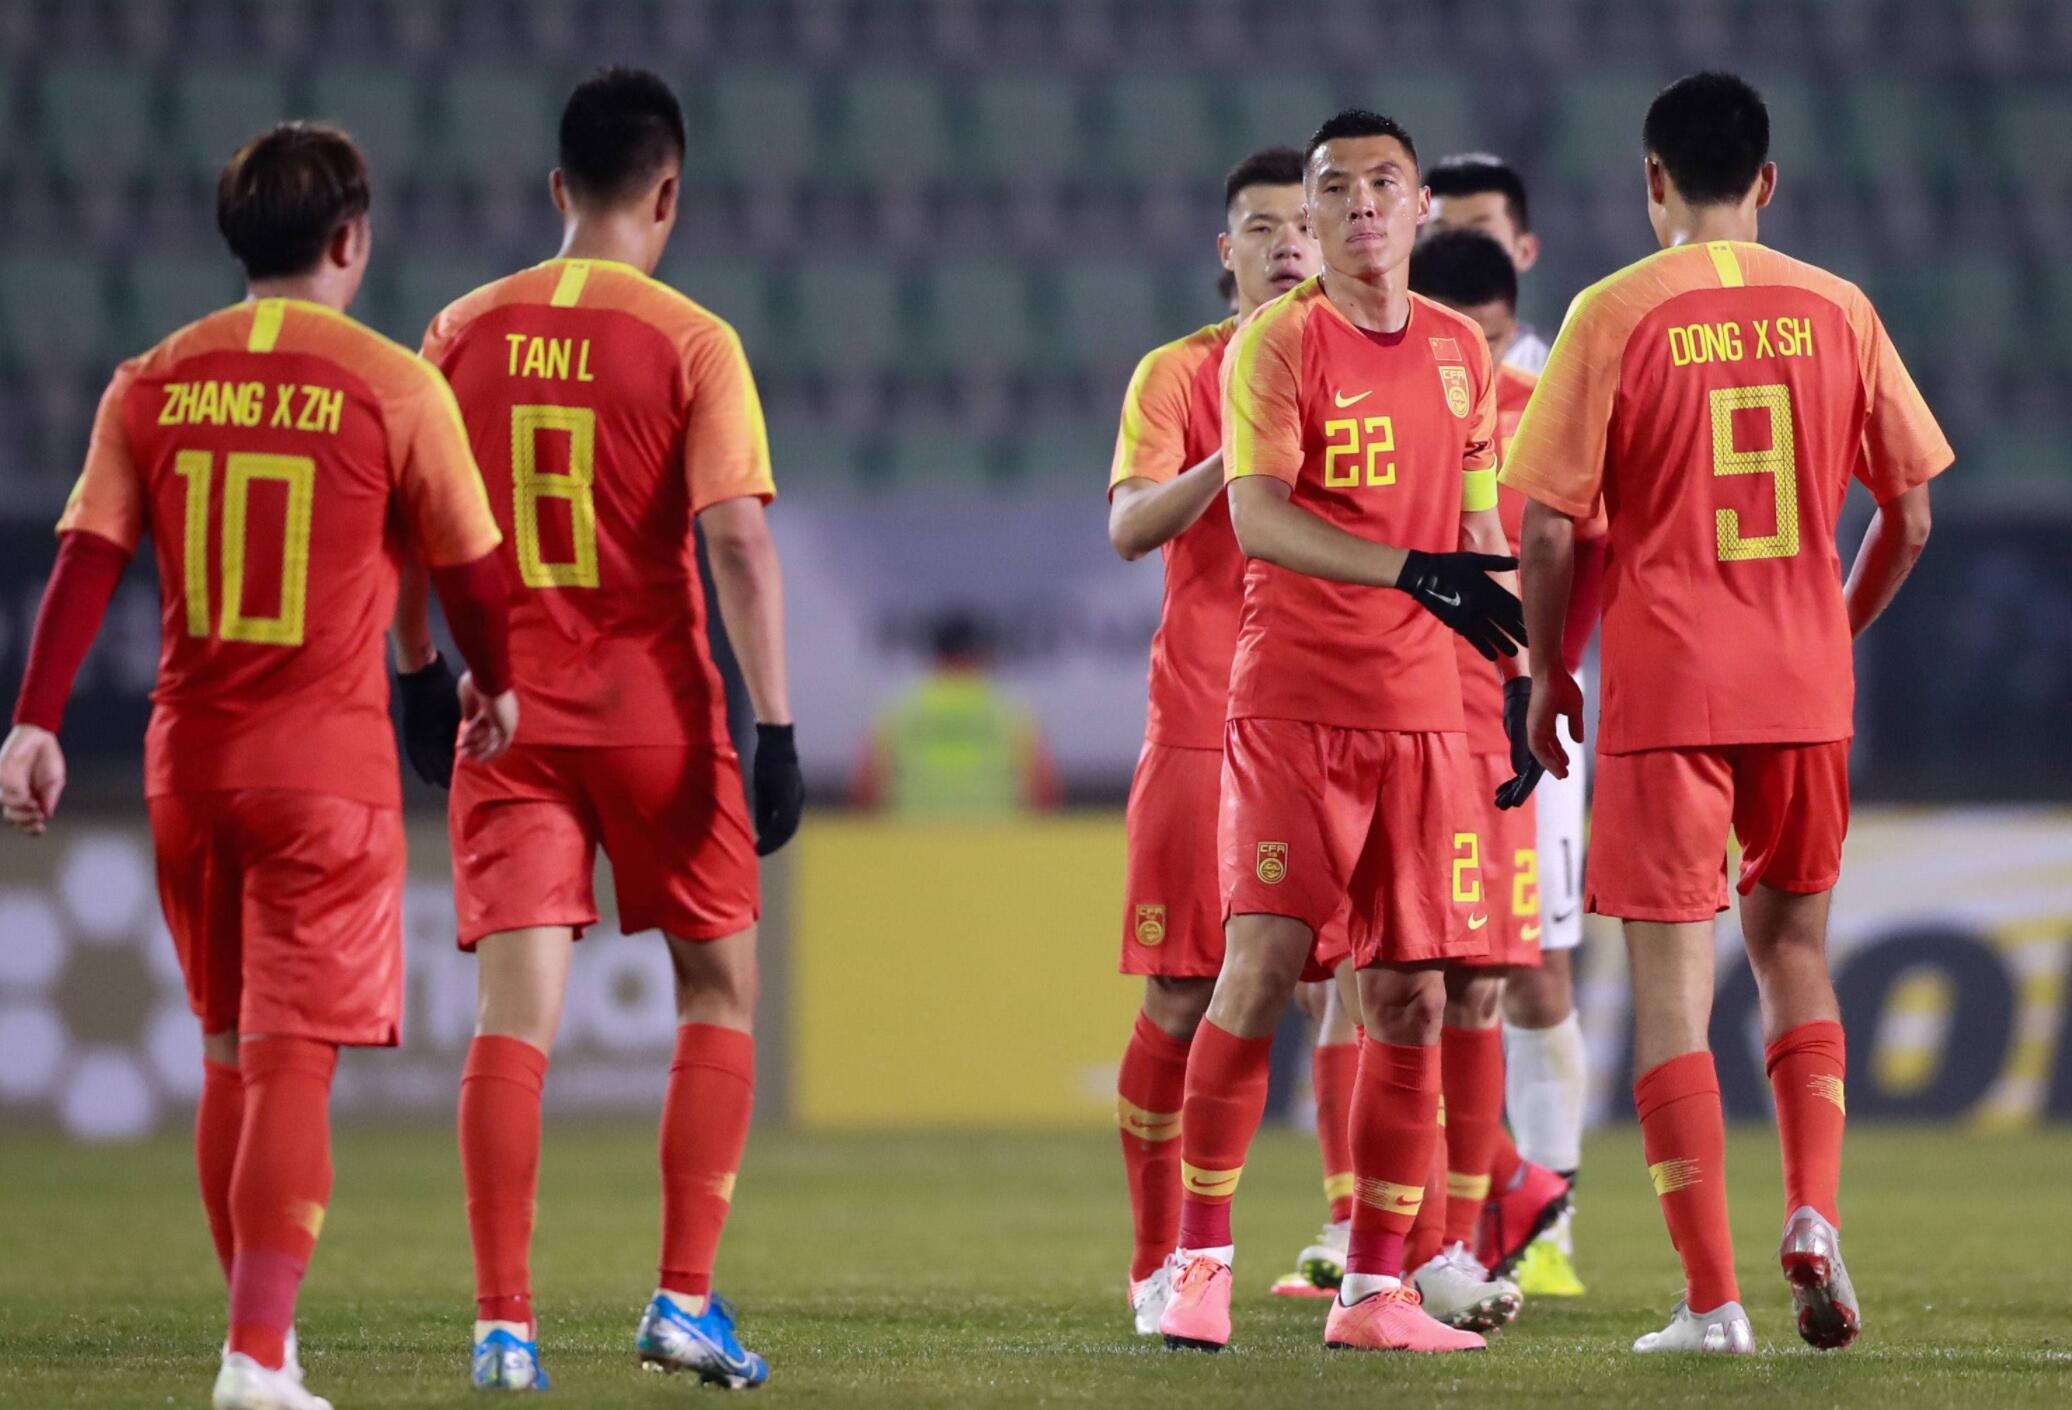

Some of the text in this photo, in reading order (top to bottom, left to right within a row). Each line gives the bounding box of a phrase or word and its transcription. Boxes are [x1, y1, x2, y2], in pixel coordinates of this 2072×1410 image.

[506, 333, 594, 382] TAN L
[1669, 317, 1813, 367] DONG X SH
[158, 381, 344, 434] ZHANG X ZH
[1324, 416, 1398, 488] 22
[1709, 384, 1800, 562] 9
[511, 405, 600, 589] 8
[175, 449, 315, 646] 10
[1260, 844, 1285, 853] CFA
[1453, 832, 1480, 903] 2
